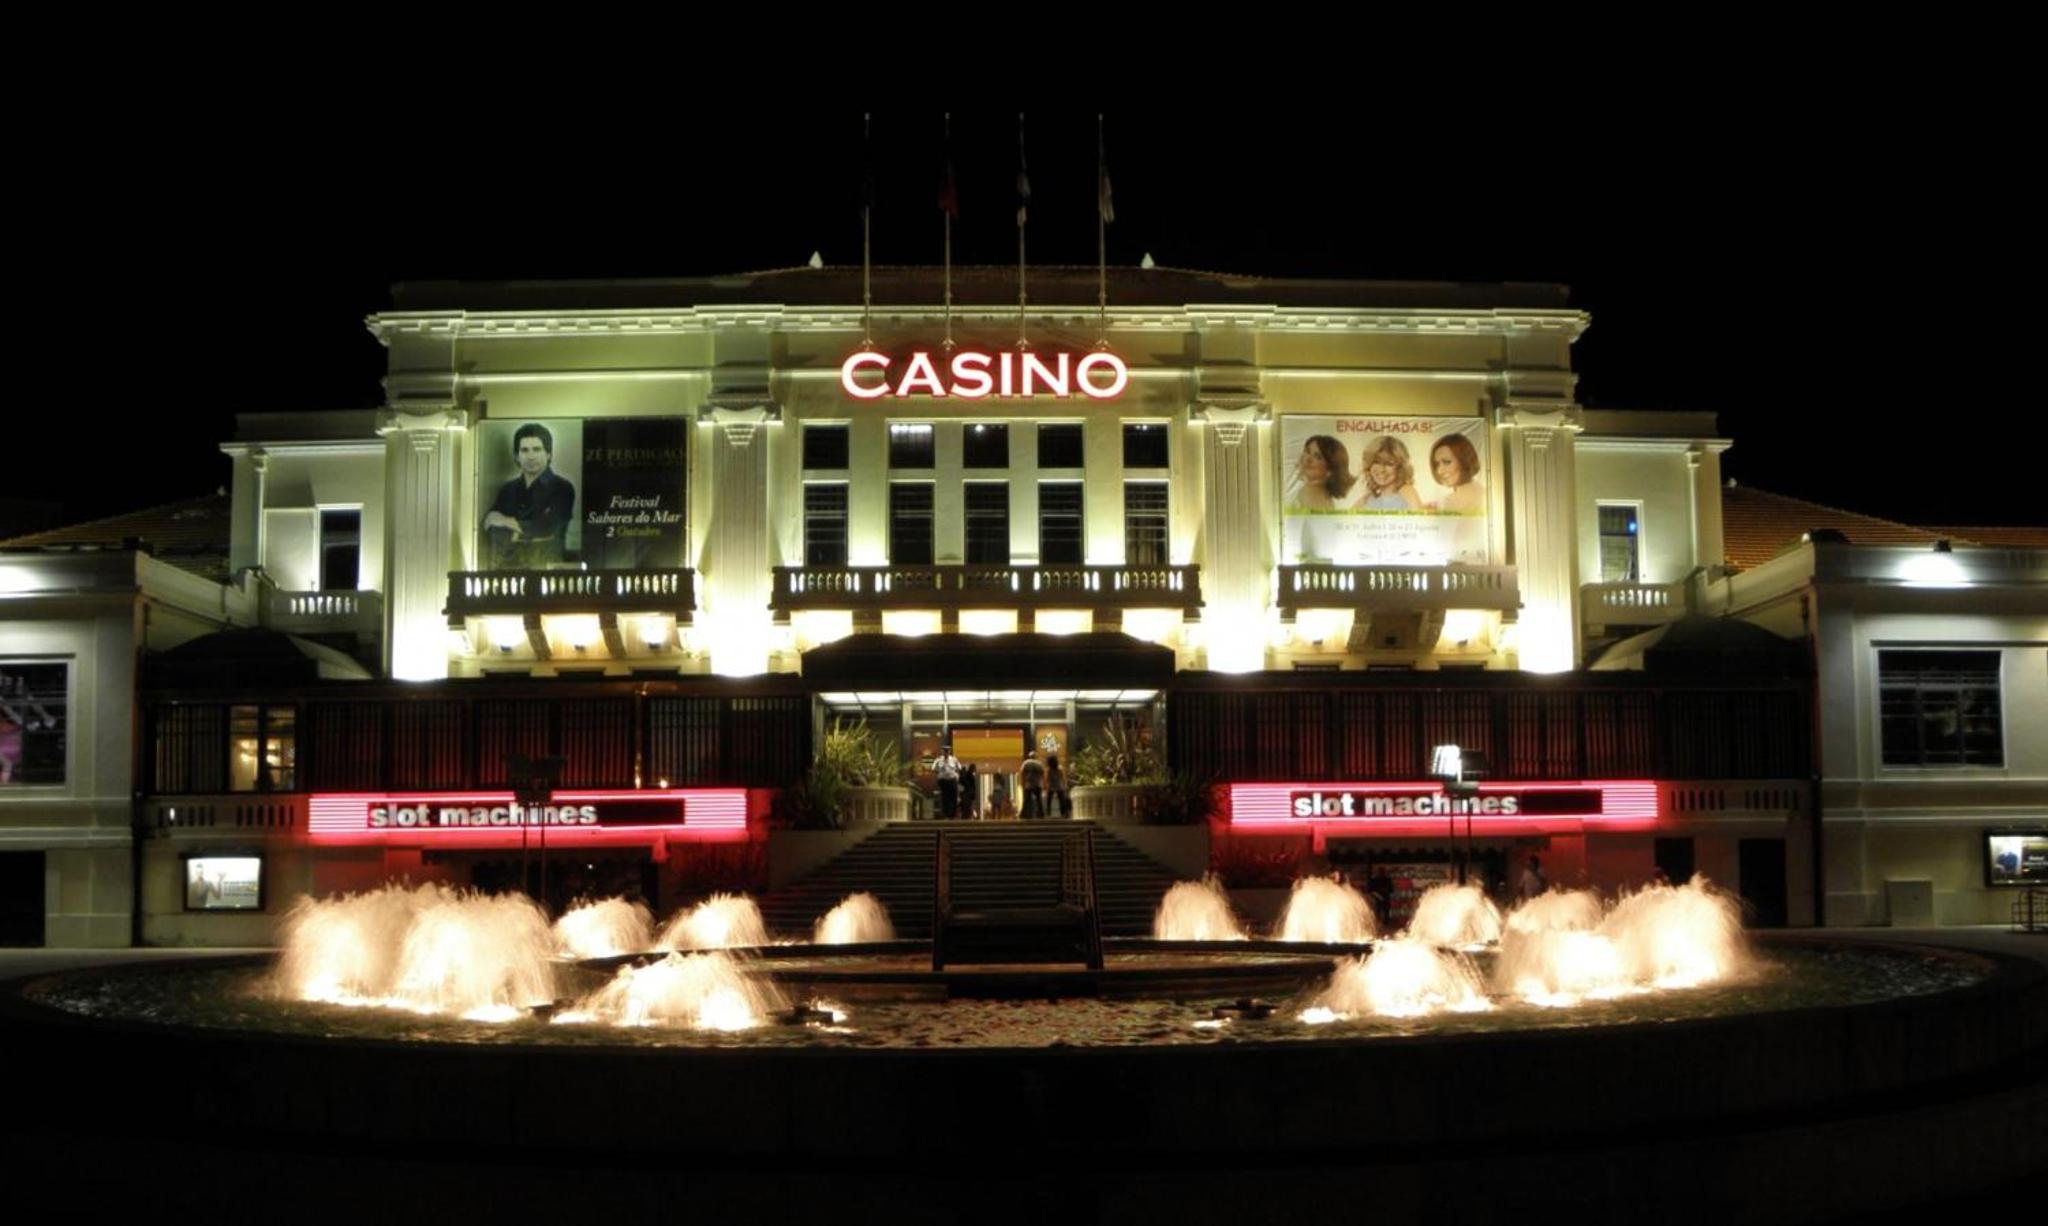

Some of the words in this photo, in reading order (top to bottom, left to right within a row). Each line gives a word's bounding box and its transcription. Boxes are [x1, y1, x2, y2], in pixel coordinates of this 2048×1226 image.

[841, 351, 1128, 398] CASINO
[1336, 420, 1432, 433] ENCALHADAS!
[610, 495, 660, 508] Festival
[587, 511, 633, 524] Sabores
[635, 511, 650, 523] do
[653, 510, 682, 523] Mar
[606, 526, 615, 537] 2
[1294, 792, 1355, 816] slot
[1364, 791, 1519, 815] machines
[369, 802, 430, 826] slot
[439, 802, 598, 826] machines
